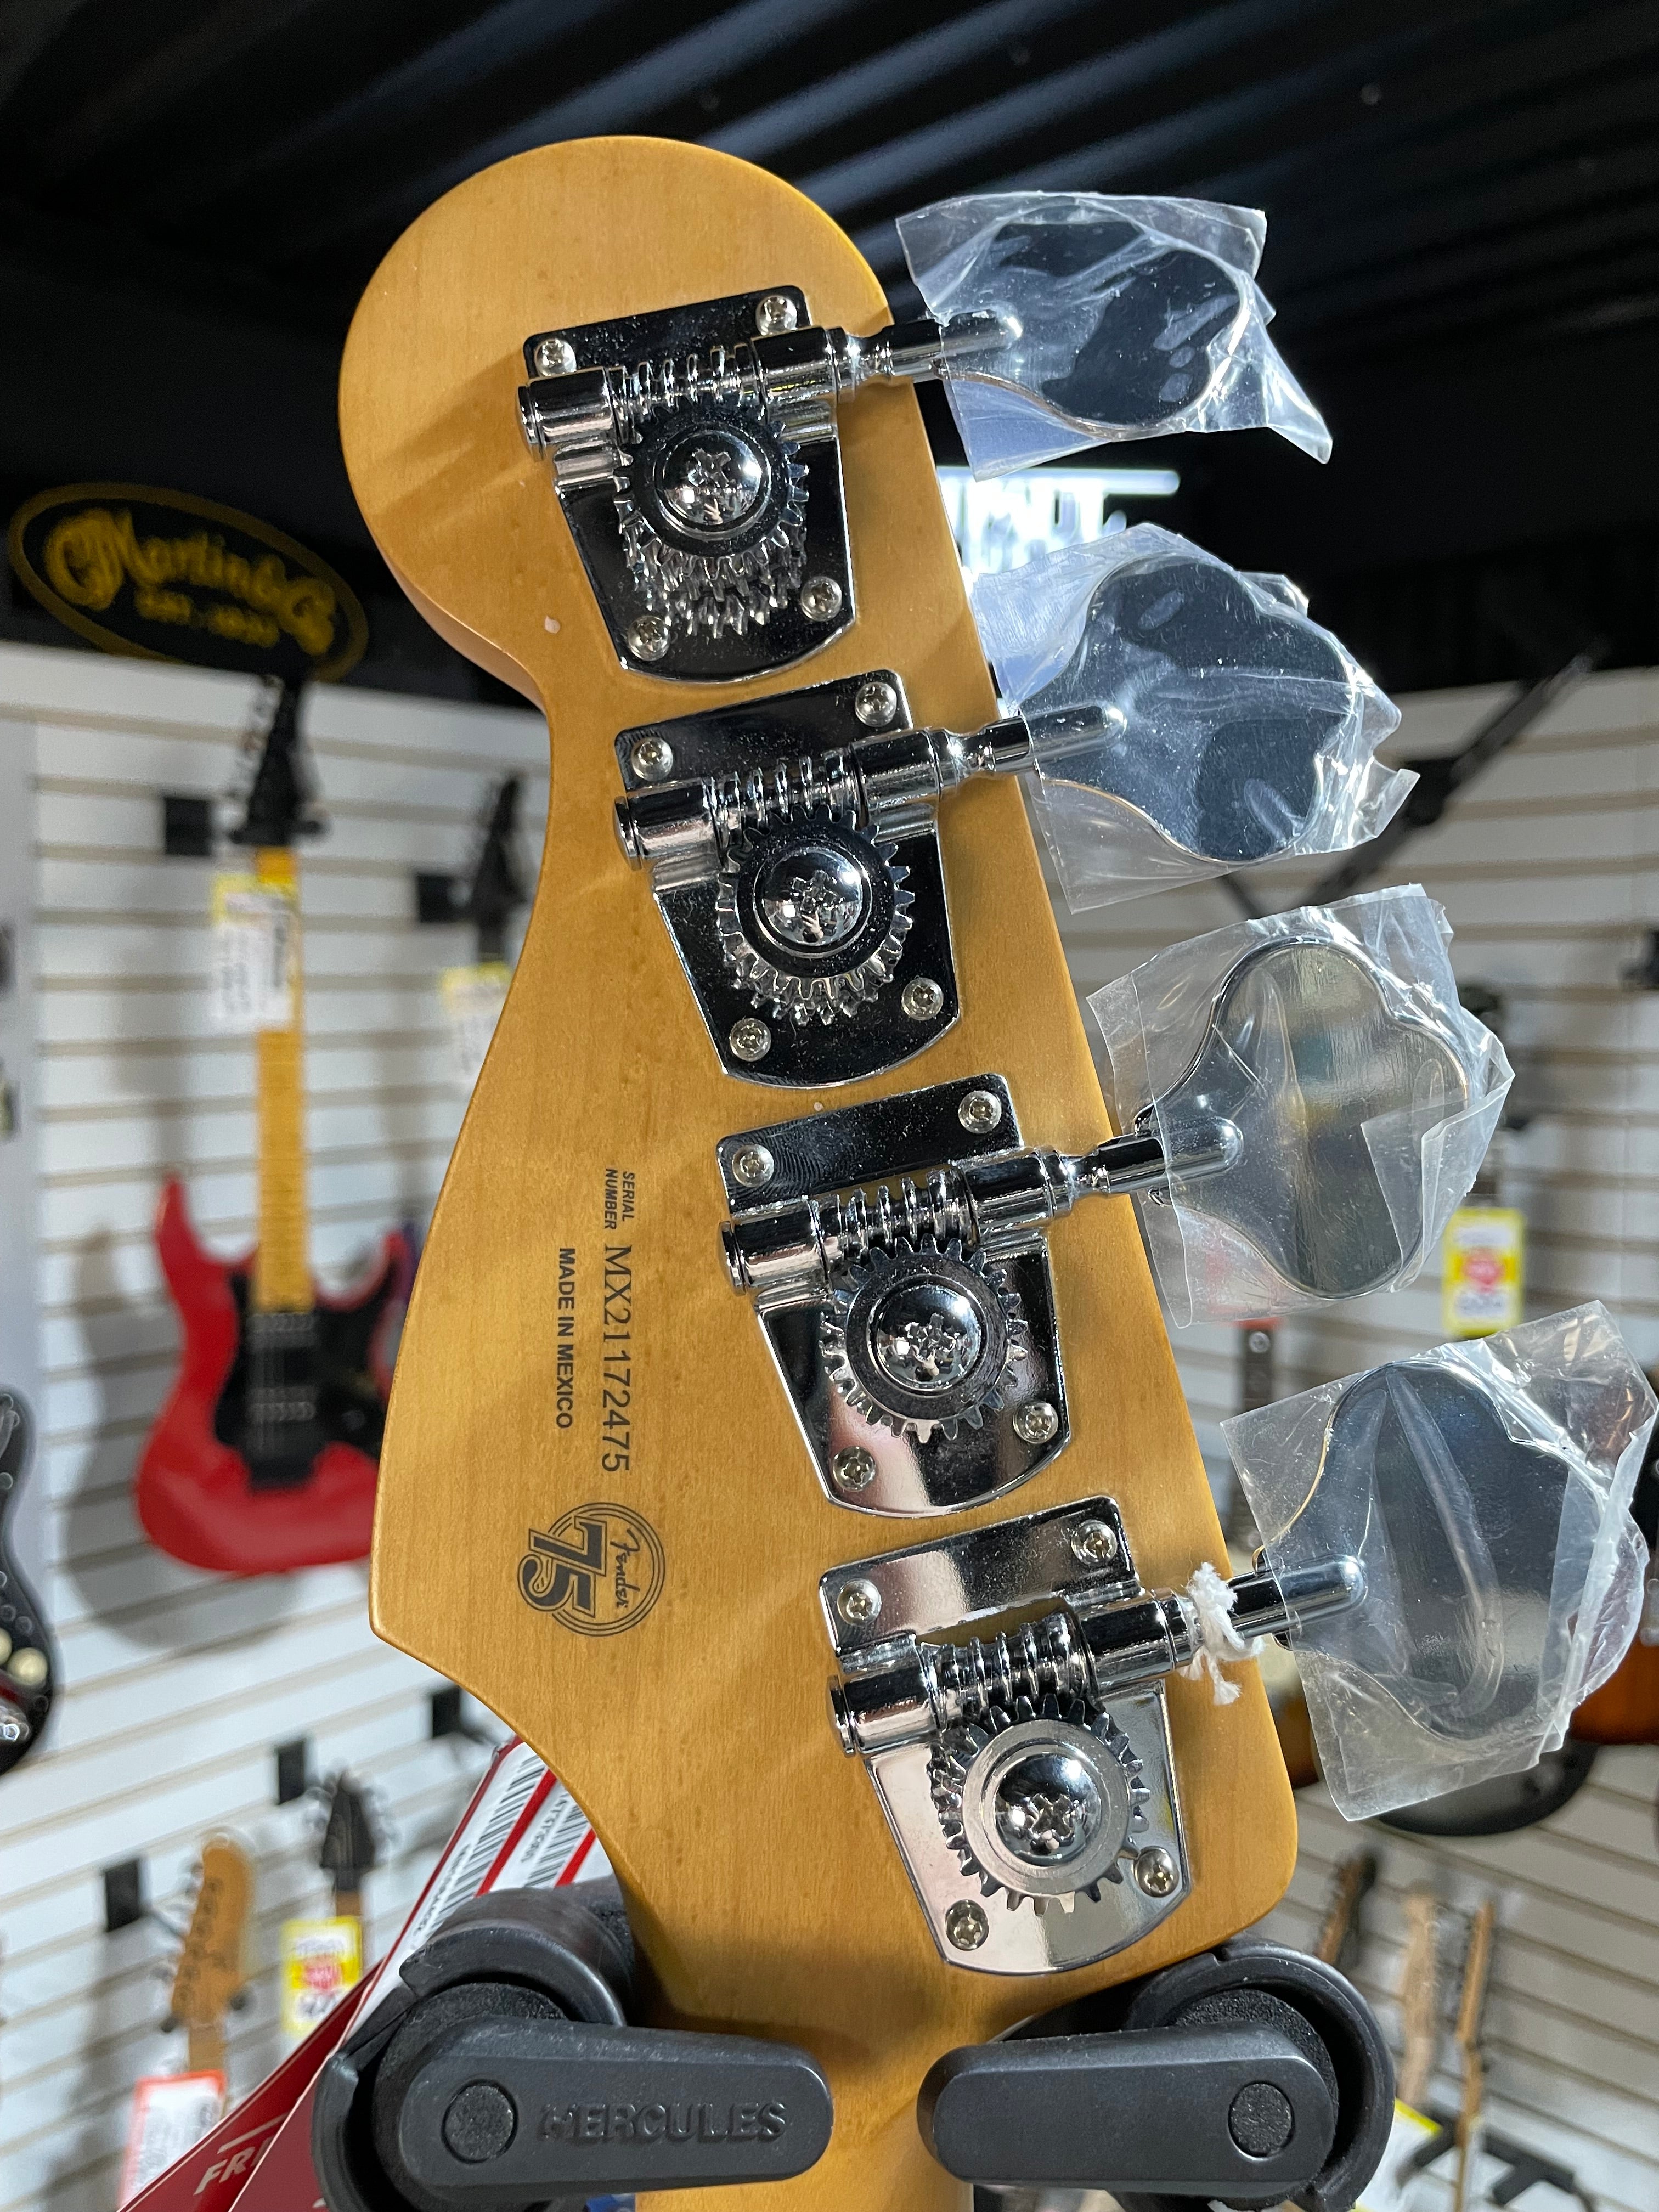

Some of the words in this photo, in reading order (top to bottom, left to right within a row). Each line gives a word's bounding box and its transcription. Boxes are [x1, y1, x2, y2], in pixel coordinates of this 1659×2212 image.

[605, 1168, 618, 1230] NUMBER
[622, 1170, 635, 1222] SERIAL
[558, 1247, 575, 1310] MADE
[557, 1316, 574, 1336] IN
[556, 1344, 574, 1429] MEXICO
[602, 1244, 633, 1472] MX21172475
[517, 1515, 607, 1616] 75
[610, 1526, 641, 1610] Fender
[537, 2102, 787, 2143] HERCULES
